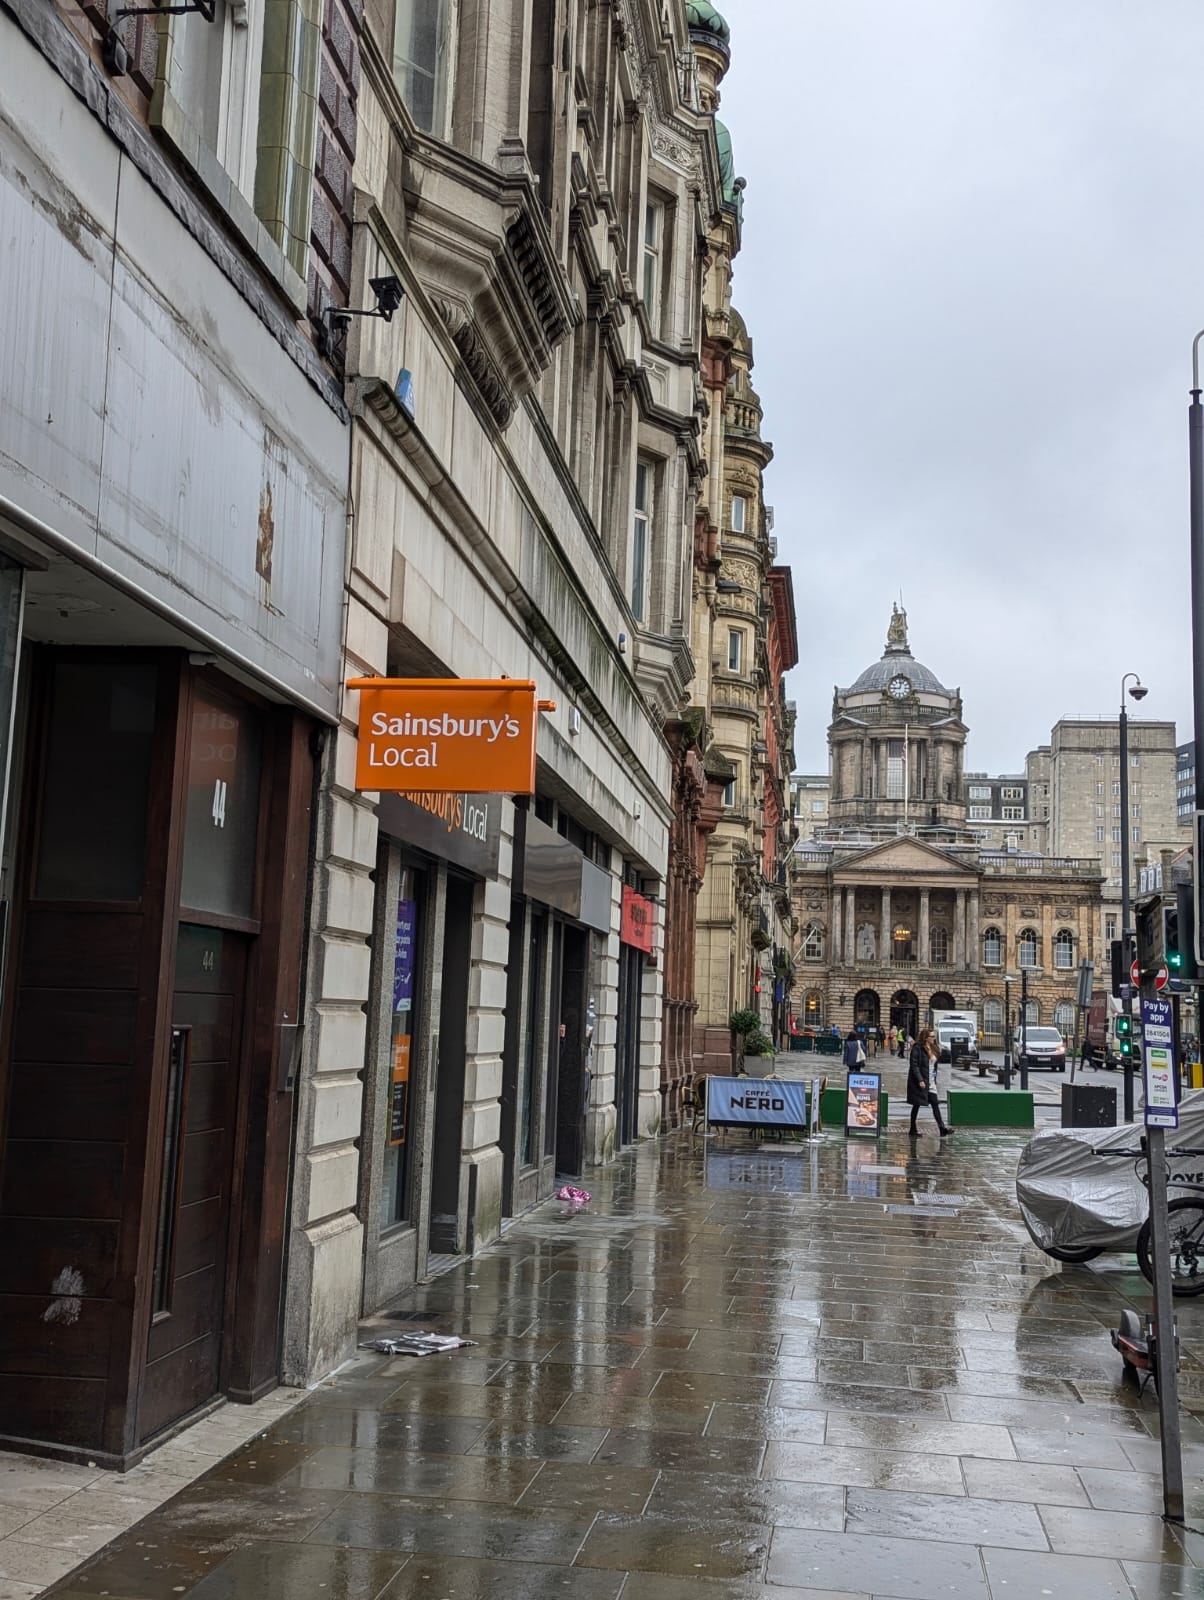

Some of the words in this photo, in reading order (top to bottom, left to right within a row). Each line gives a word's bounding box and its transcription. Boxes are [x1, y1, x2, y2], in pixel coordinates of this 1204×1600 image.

[371, 712, 520, 742] Sainsbury's
[369, 742, 438, 767] Local
[212, 779, 227, 828] 44
[398, 792, 462, 832] nsburys
[463, 793, 488, 842] Local
[203, 951, 214, 971] 44
[1144, 1000, 1158, 1012] Pay
[1160, 1002, 1169, 1014] by
[1150, 1014, 1165, 1024] app
[730, 1096, 785, 1111] NERO
